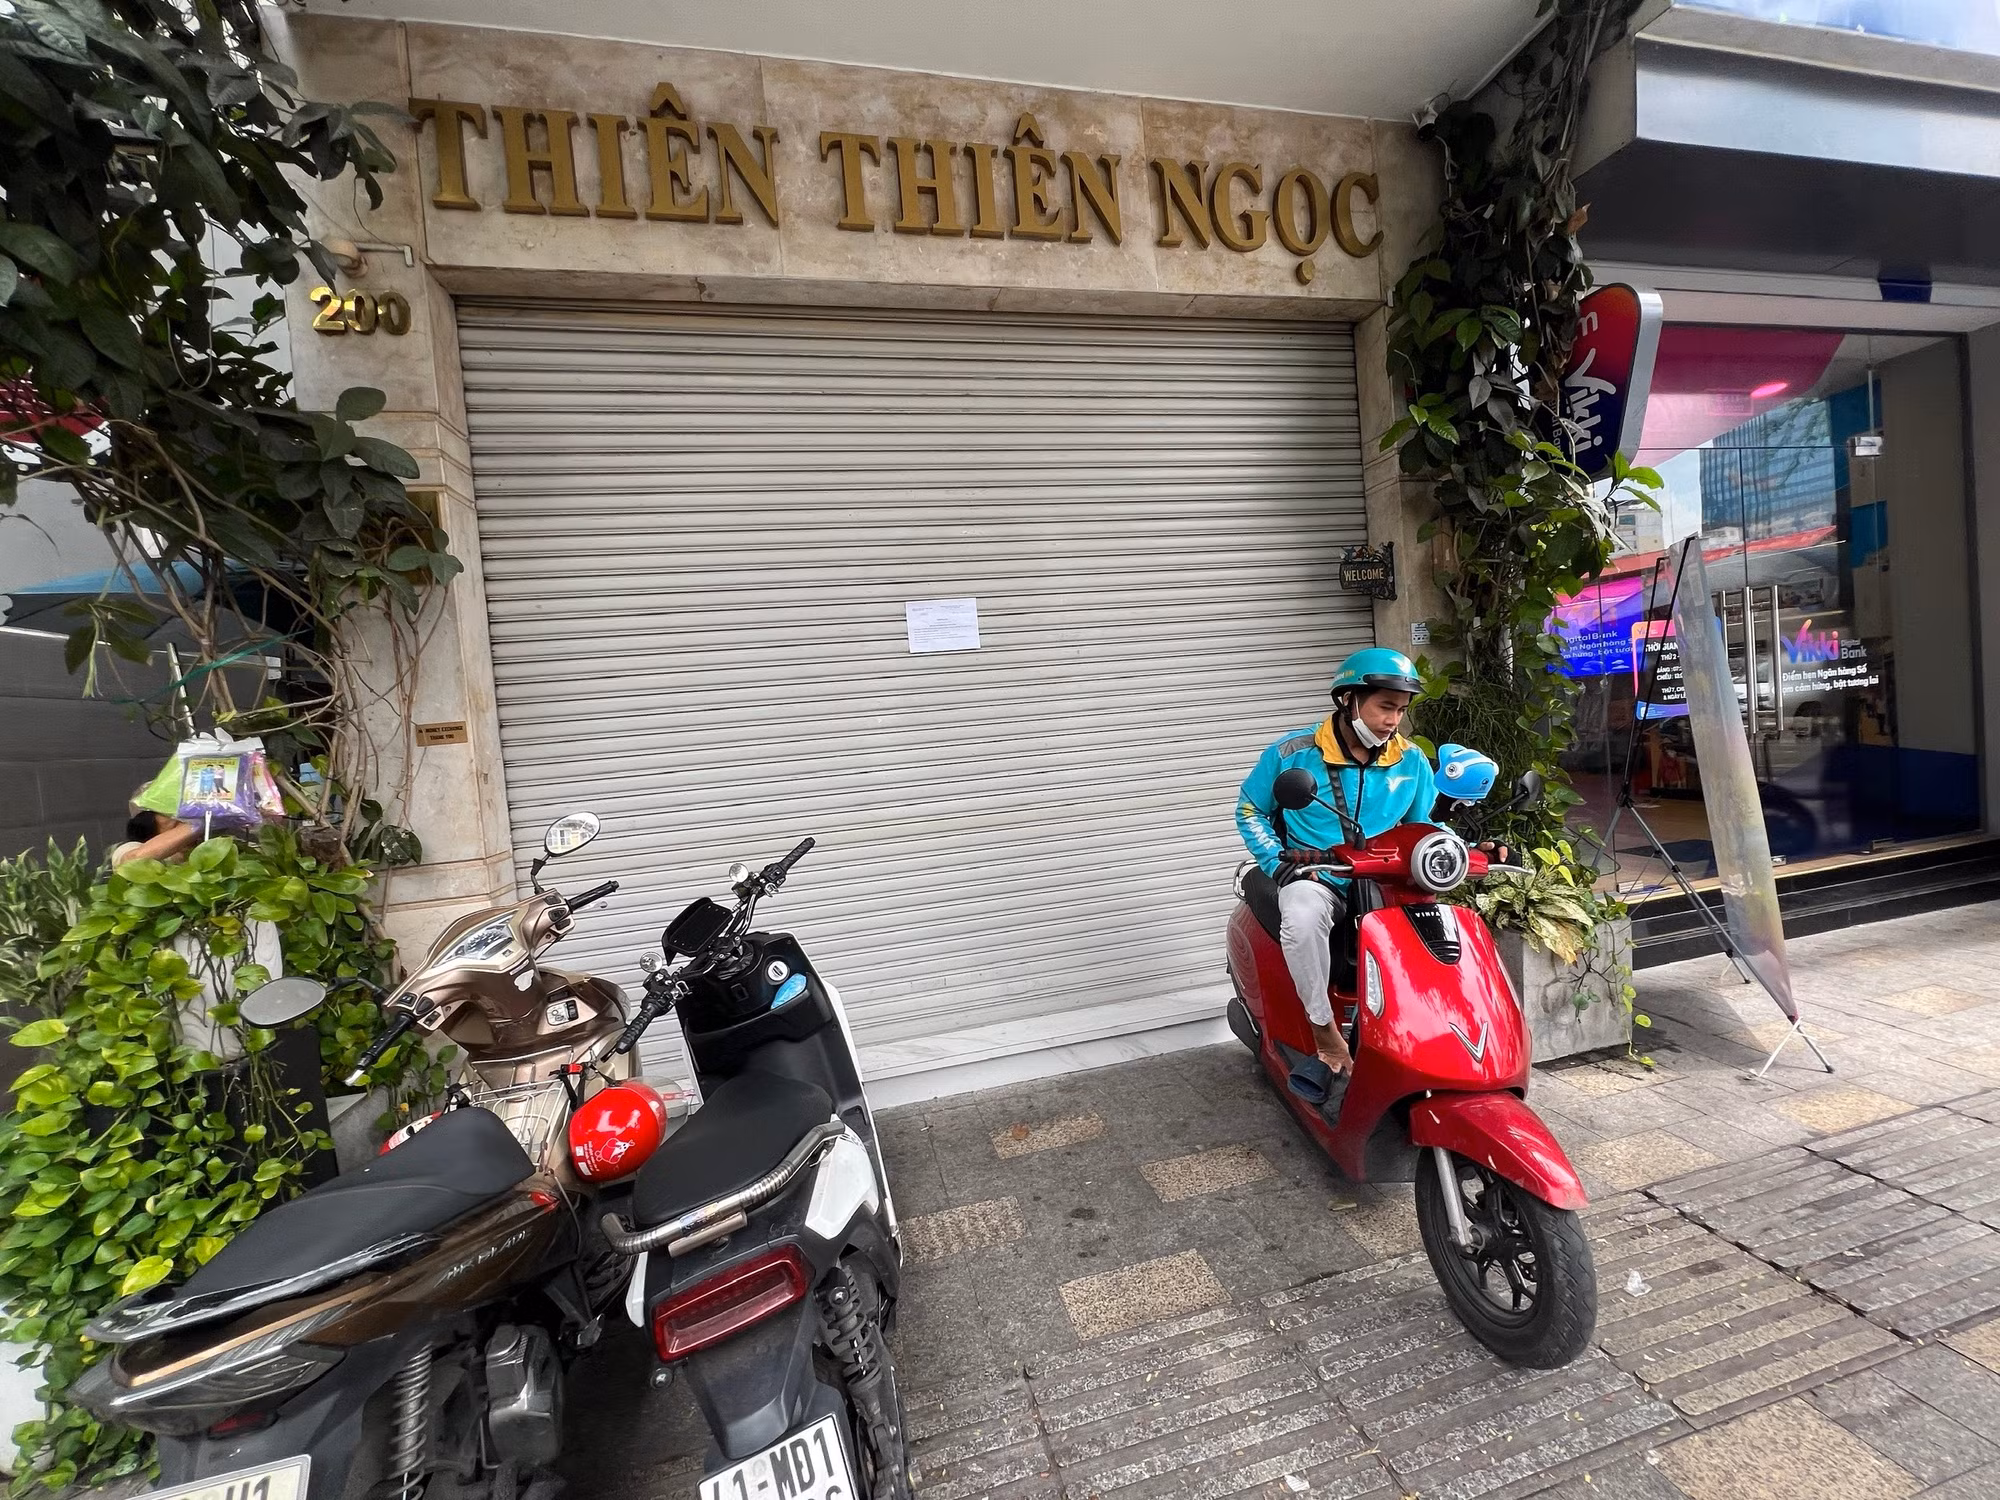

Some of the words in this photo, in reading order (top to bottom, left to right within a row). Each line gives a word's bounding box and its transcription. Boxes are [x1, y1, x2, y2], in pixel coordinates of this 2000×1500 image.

[407, 82, 780, 228] THIÊN
[819, 111, 1123, 246] THIÊN
[1151, 157, 1384, 286] NGỌC
[310, 286, 412, 336] 200
[1565, 347, 1617, 455] Vikki
[1343, 568, 1384, 581] WELCOME
[1566, 633, 1591, 643] igital
[1779, 618, 1838, 664] Vikki
[1841, 645, 1867, 659] Bank
[1817, 667, 1837, 680] Ngân
[1838, 666, 1856, 677] hàng
[1857, 663, 1867, 674] Số
